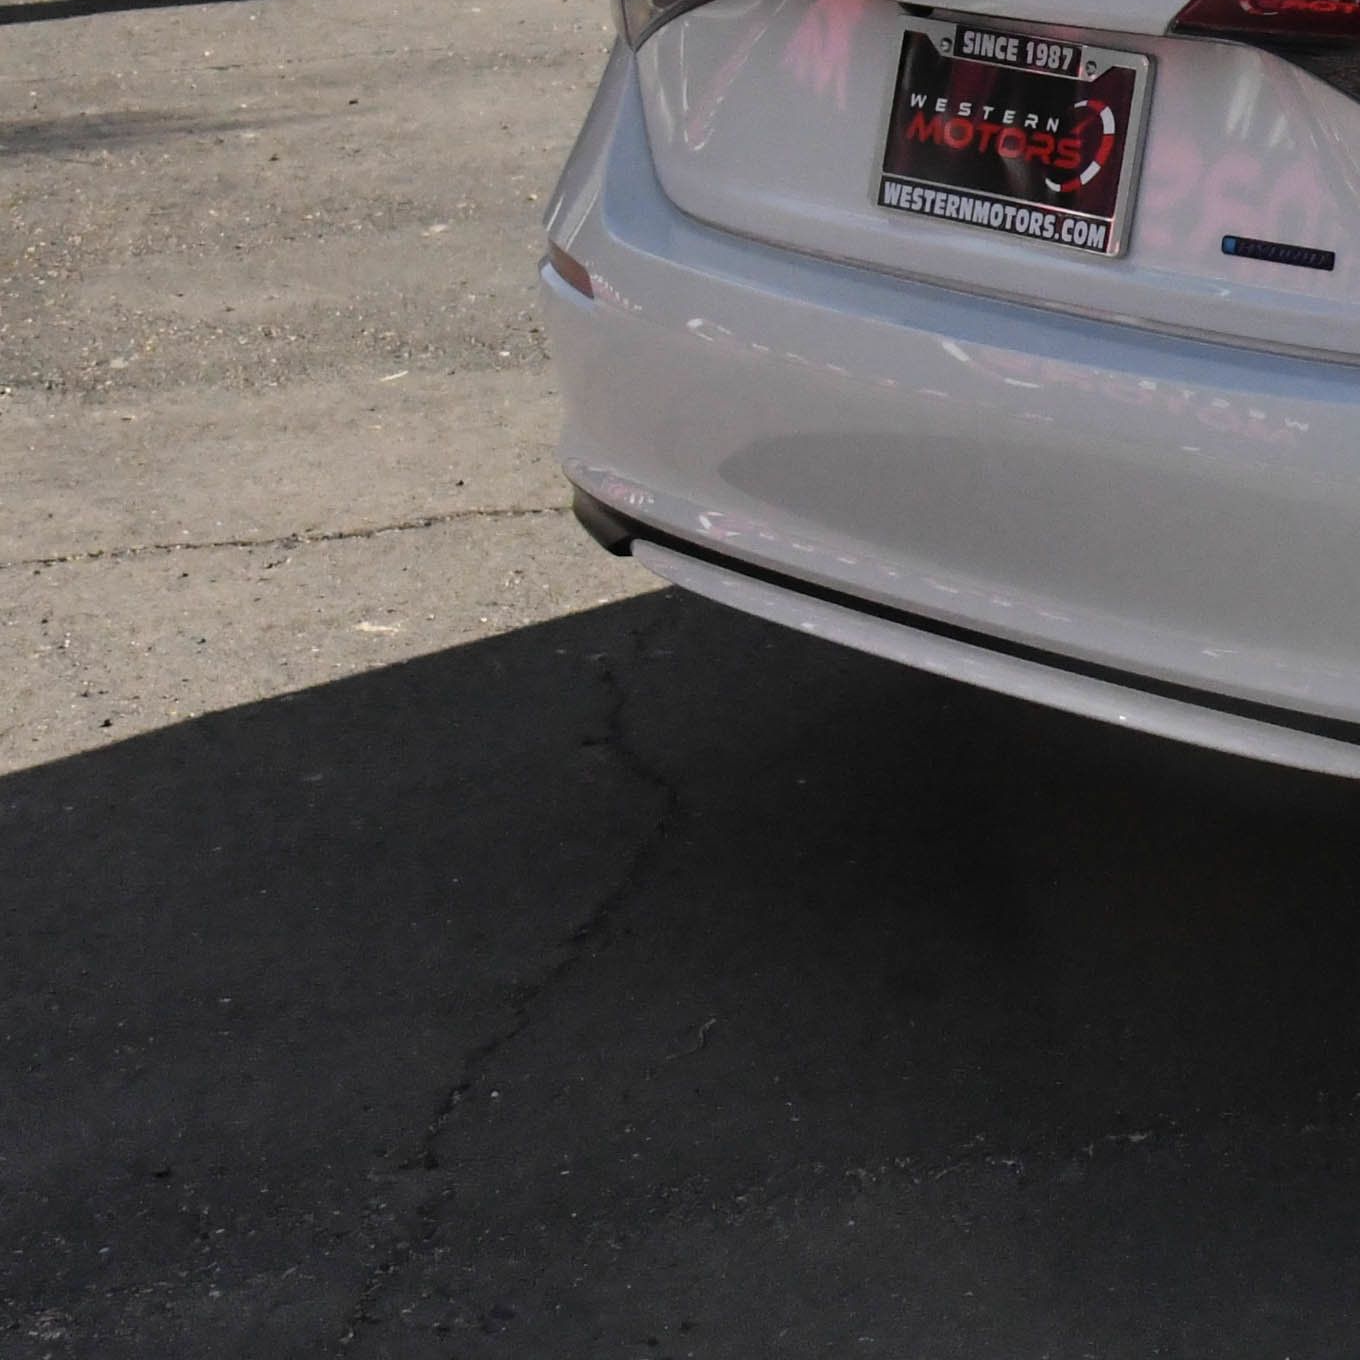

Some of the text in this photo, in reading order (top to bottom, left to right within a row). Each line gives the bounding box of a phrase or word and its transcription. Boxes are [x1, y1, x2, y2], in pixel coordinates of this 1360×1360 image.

[962, 31, 1073, 71] SINCE 1987
[910, 93, 1060, 133] WESTERN
[907, 111, 1082, 169] MOTORS
[884, 181, 1106, 249] WESTERNMOTORS.COM
